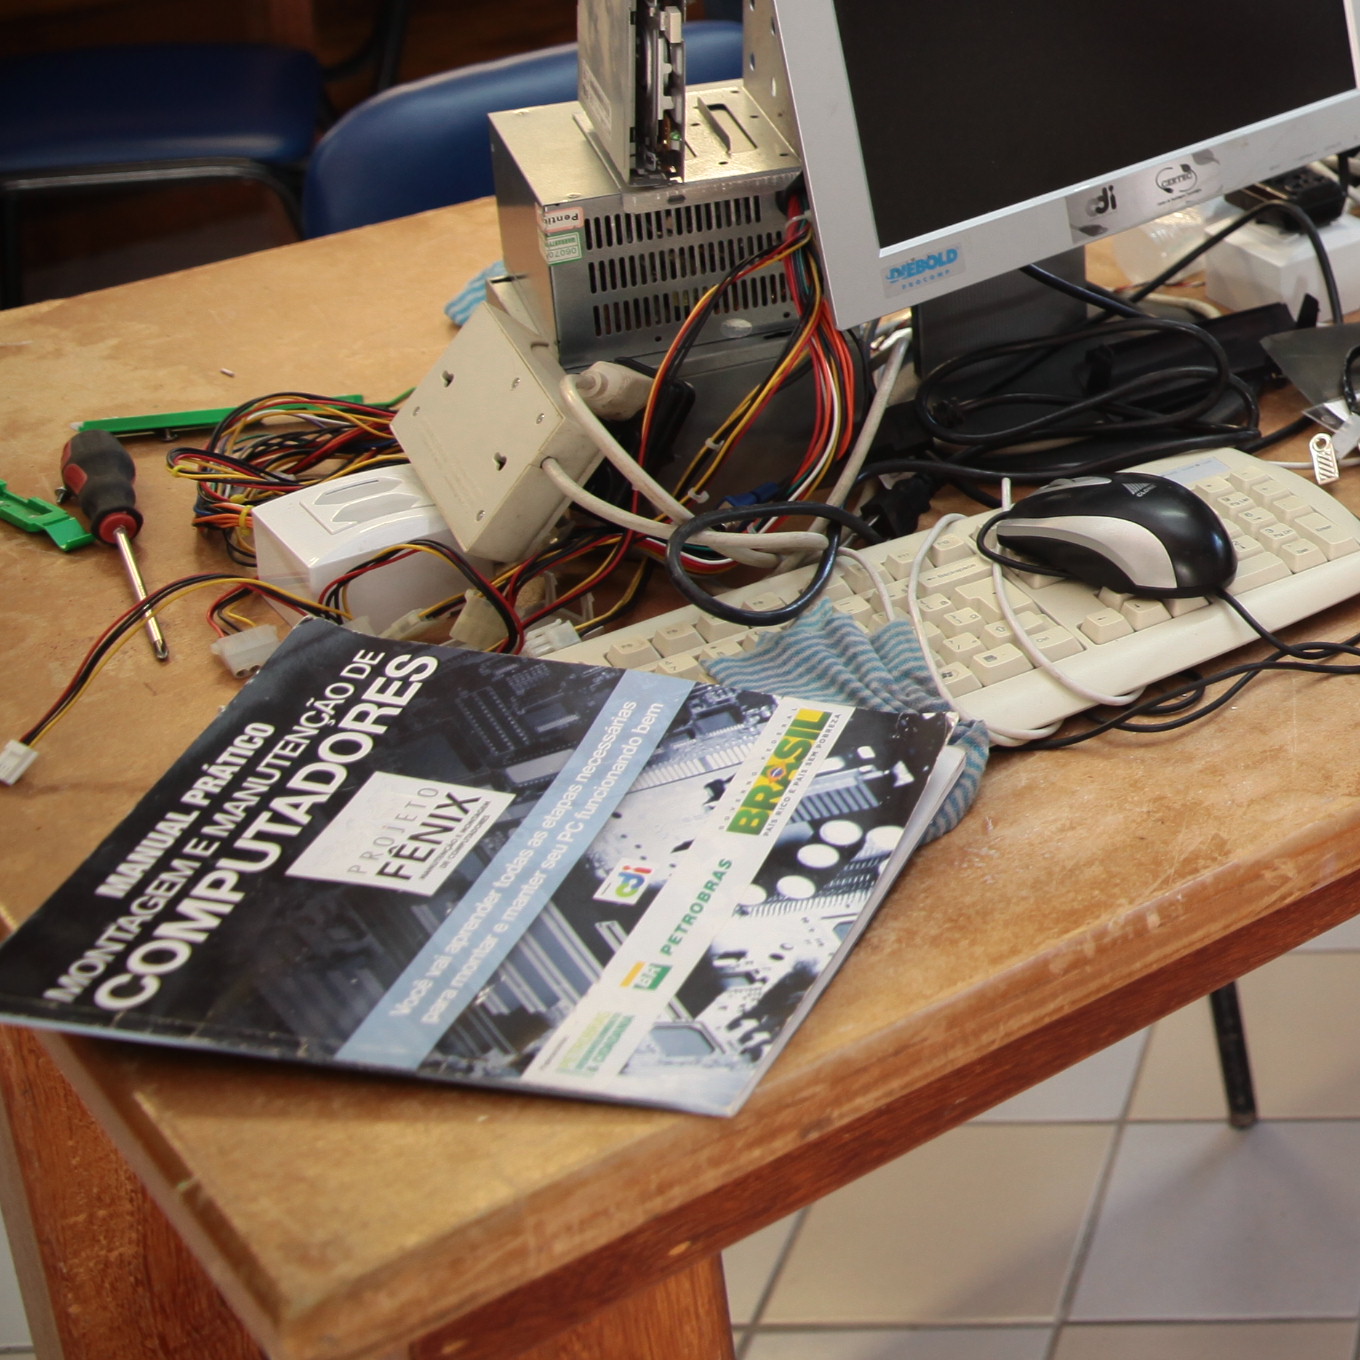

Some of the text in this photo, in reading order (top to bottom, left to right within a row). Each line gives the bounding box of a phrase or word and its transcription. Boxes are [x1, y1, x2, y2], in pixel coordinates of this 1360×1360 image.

[1161, 171, 1193, 187] CERTEC
[885, 248, 959, 282] DIEBOLD
[95, 722, 275, 899] MANUAL PRÁTICO
[726, 708, 833, 836] BRASIL
[775, 796, 791, 817] RICO
[815, 713, 842, 750] POBREZA
[43, 649, 386, 1003] MONTAGEM E MANUTENÇÃO DE
[94, 653, 440, 1011] COMPUTADORES
[347, 787, 440, 875] PROJETO
[376, 791, 483, 881] FÊNIX
[388, 699, 638, 1017] Você vai aprender todas as etapas necessárias
[420, 701, 665, 1026] para montar e manter seu PC funcionando bem
[615, 865, 652, 898] cdi
[660, 858, 733, 957] PETROBRAS
